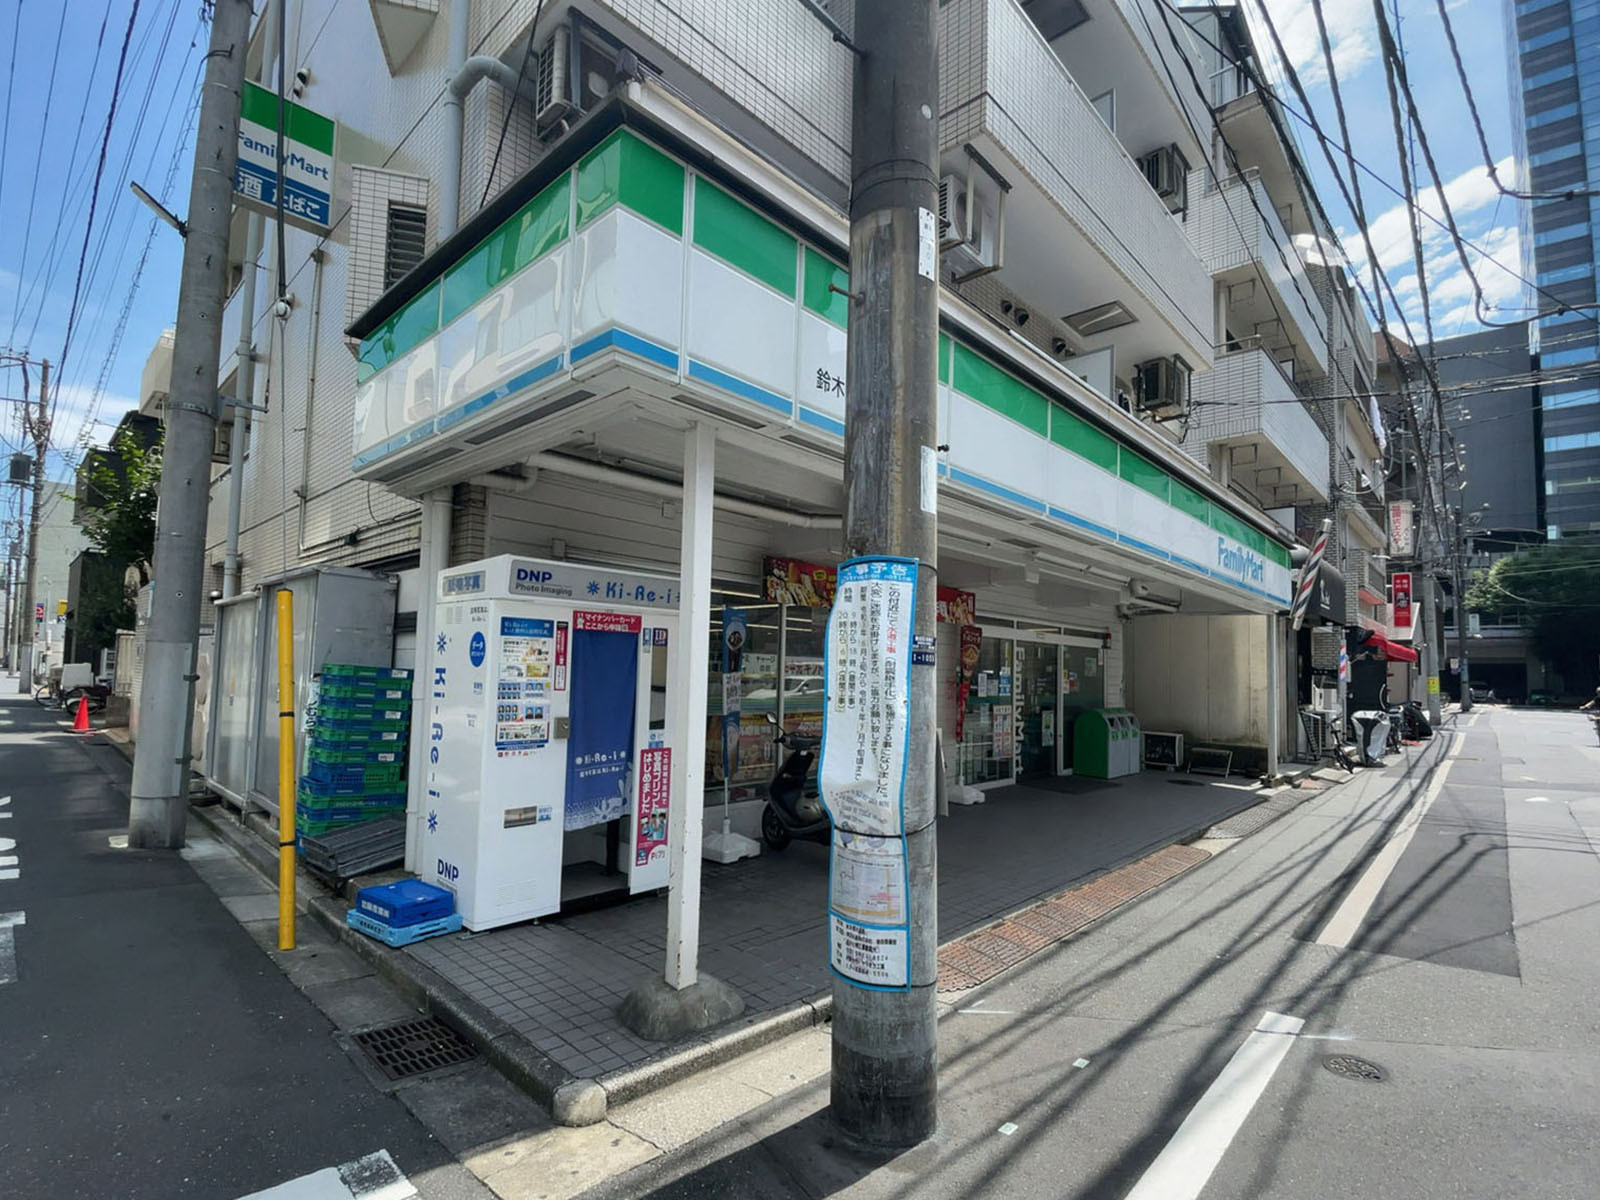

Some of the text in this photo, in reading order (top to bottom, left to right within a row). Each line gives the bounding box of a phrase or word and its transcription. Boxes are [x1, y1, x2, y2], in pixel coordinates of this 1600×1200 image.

[238, 131, 329, 181] FamiyMart
[238, 171, 321, 220] 酒 たばこ
[816, 368, 845, 398] 鈴木
[844, 562, 908, 577] 事予告
[1217, 537, 1263, 582] FamilyMart
[516, 568, 553, 583] DNP
[515, 583, 573, 597] Photo Imaging
[606, 582, 671, 602] Ki-Re-i
[584, 613, 636, 624] マイナンバーカード
[655, 629, 667, 641] ID
[641, 752, 653, 813] はじめました
[437, 859, 460, 882] DNP
